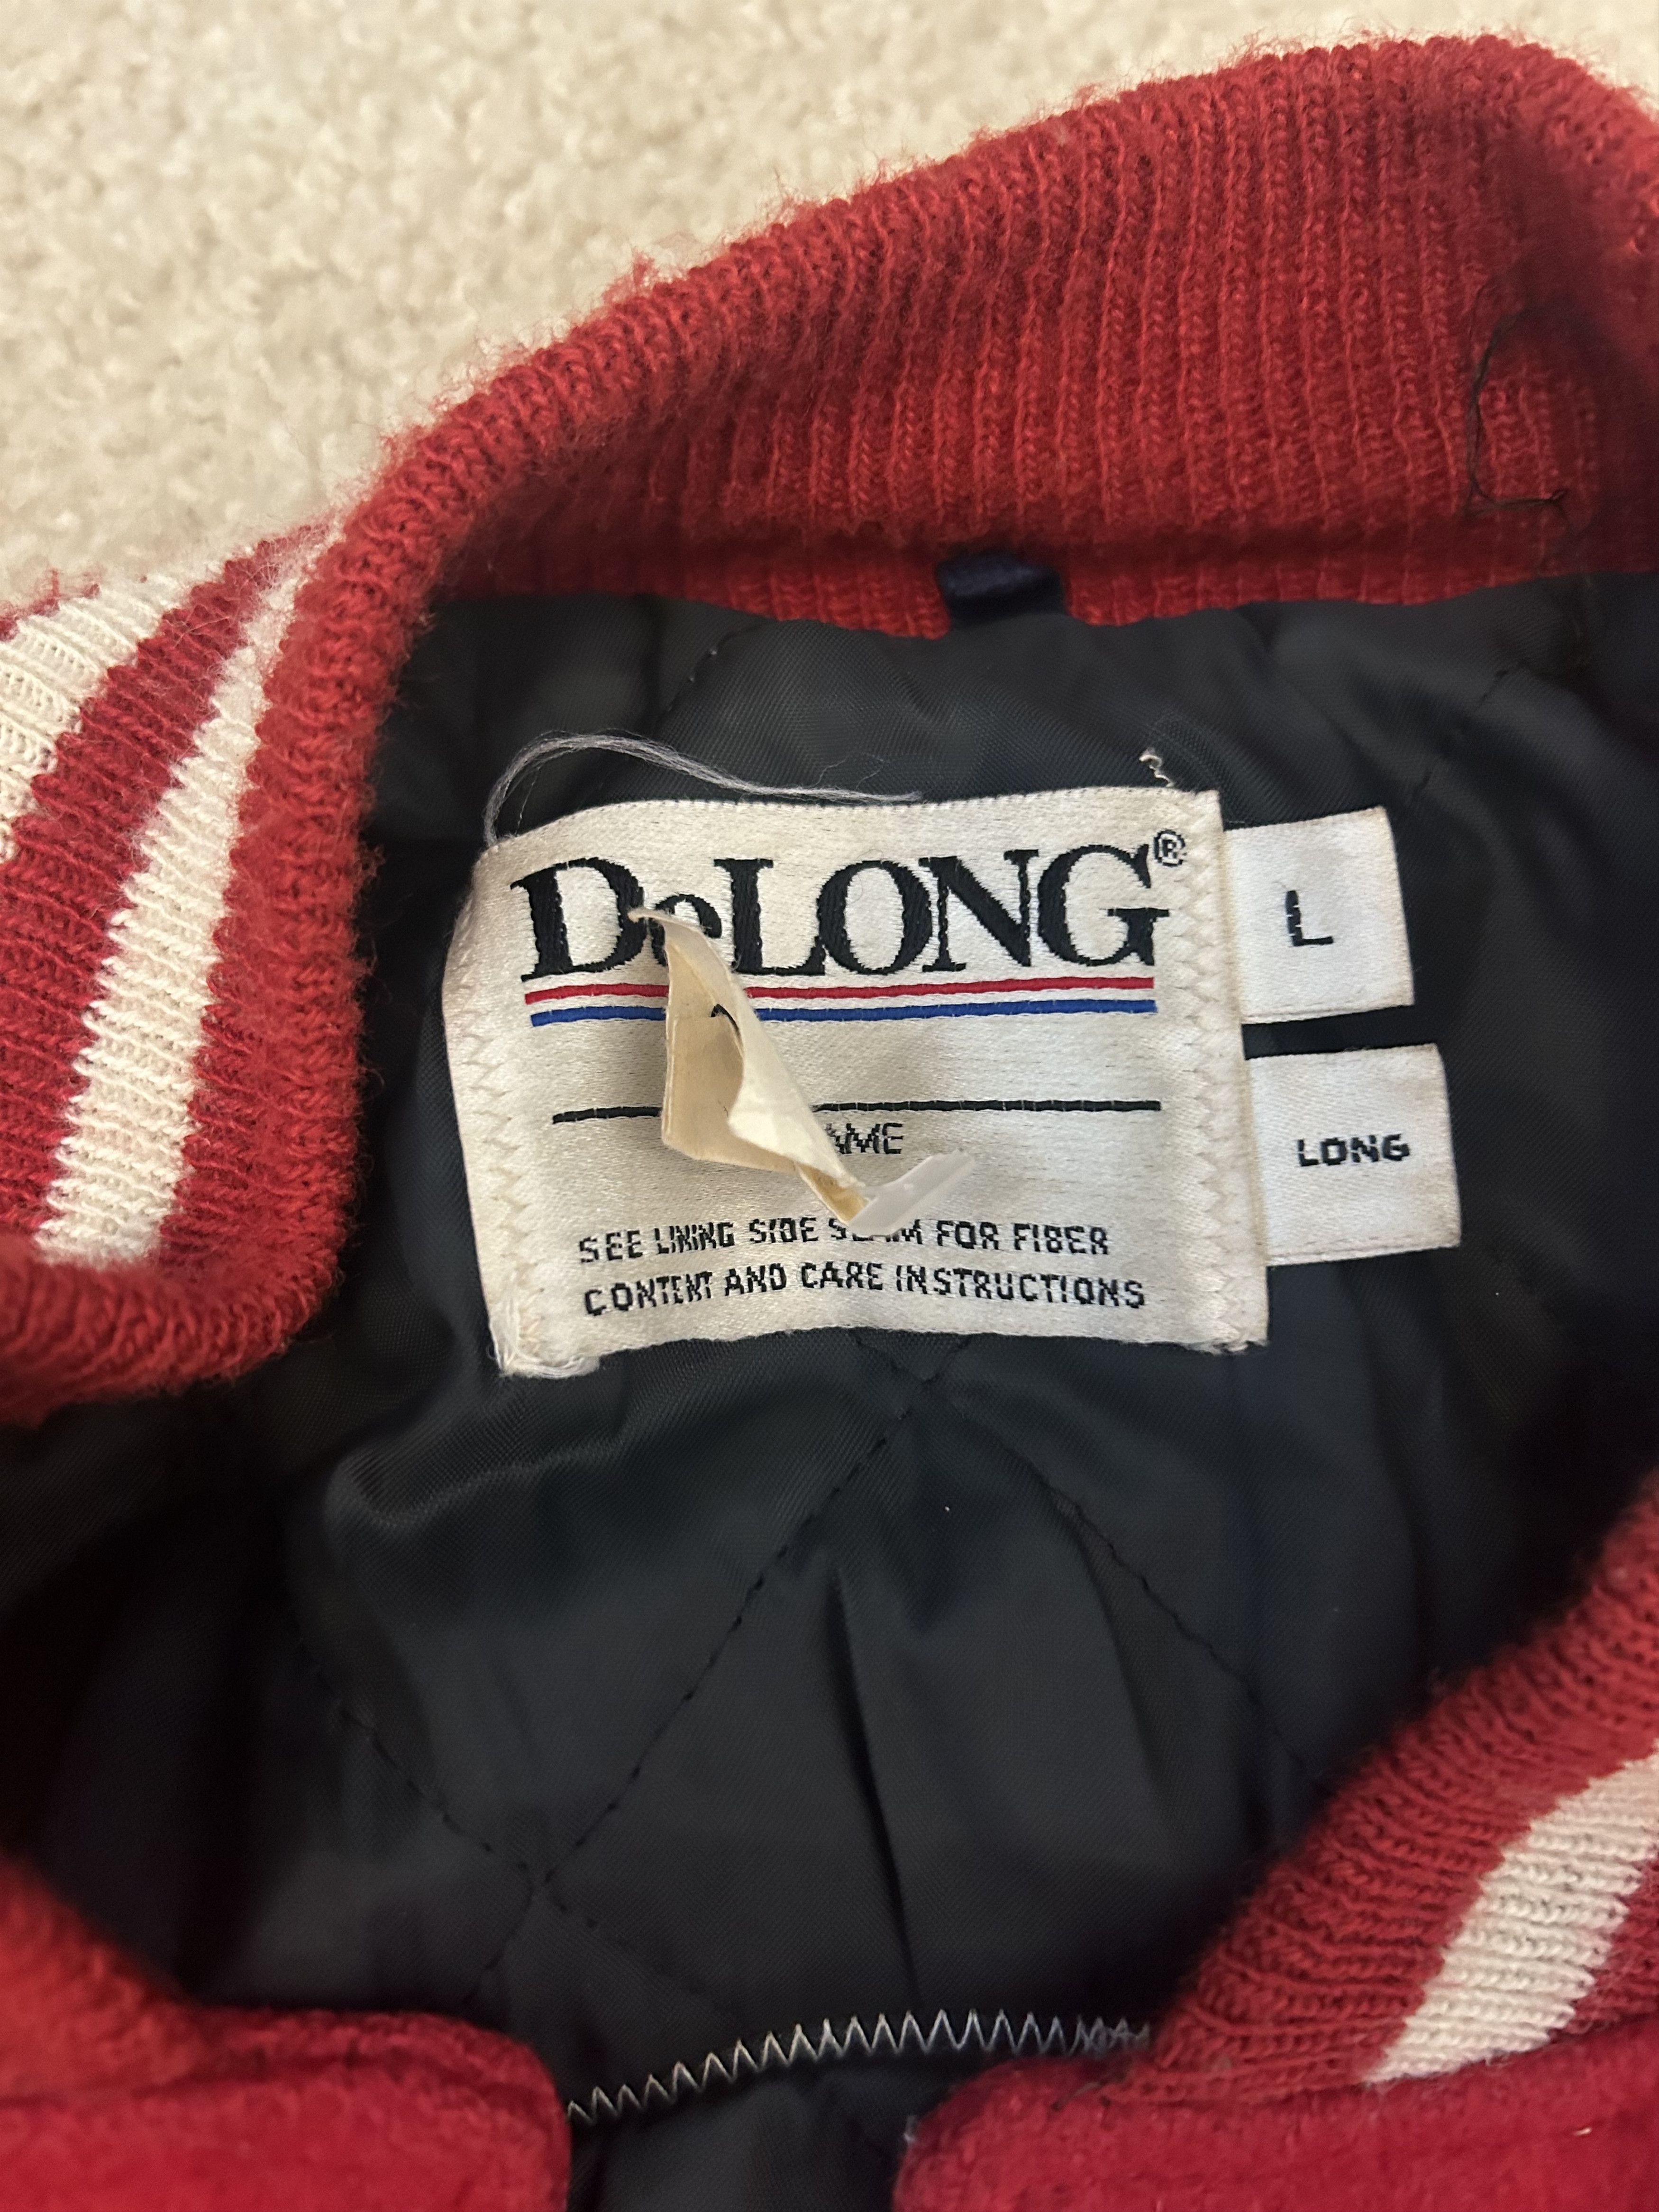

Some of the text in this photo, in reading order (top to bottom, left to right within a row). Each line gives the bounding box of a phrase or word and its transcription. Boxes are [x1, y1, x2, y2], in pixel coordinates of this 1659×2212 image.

[1284, 889, 1335, 947] L
[1297, 1133, 1411, 1167] LONG
[579, 1217, 1109, 1264] SEE LINING SIDE SM FOR FIBER
[584, 1261, 1146, 1316] CONTENT AND CARE INSTRUCTIONS
